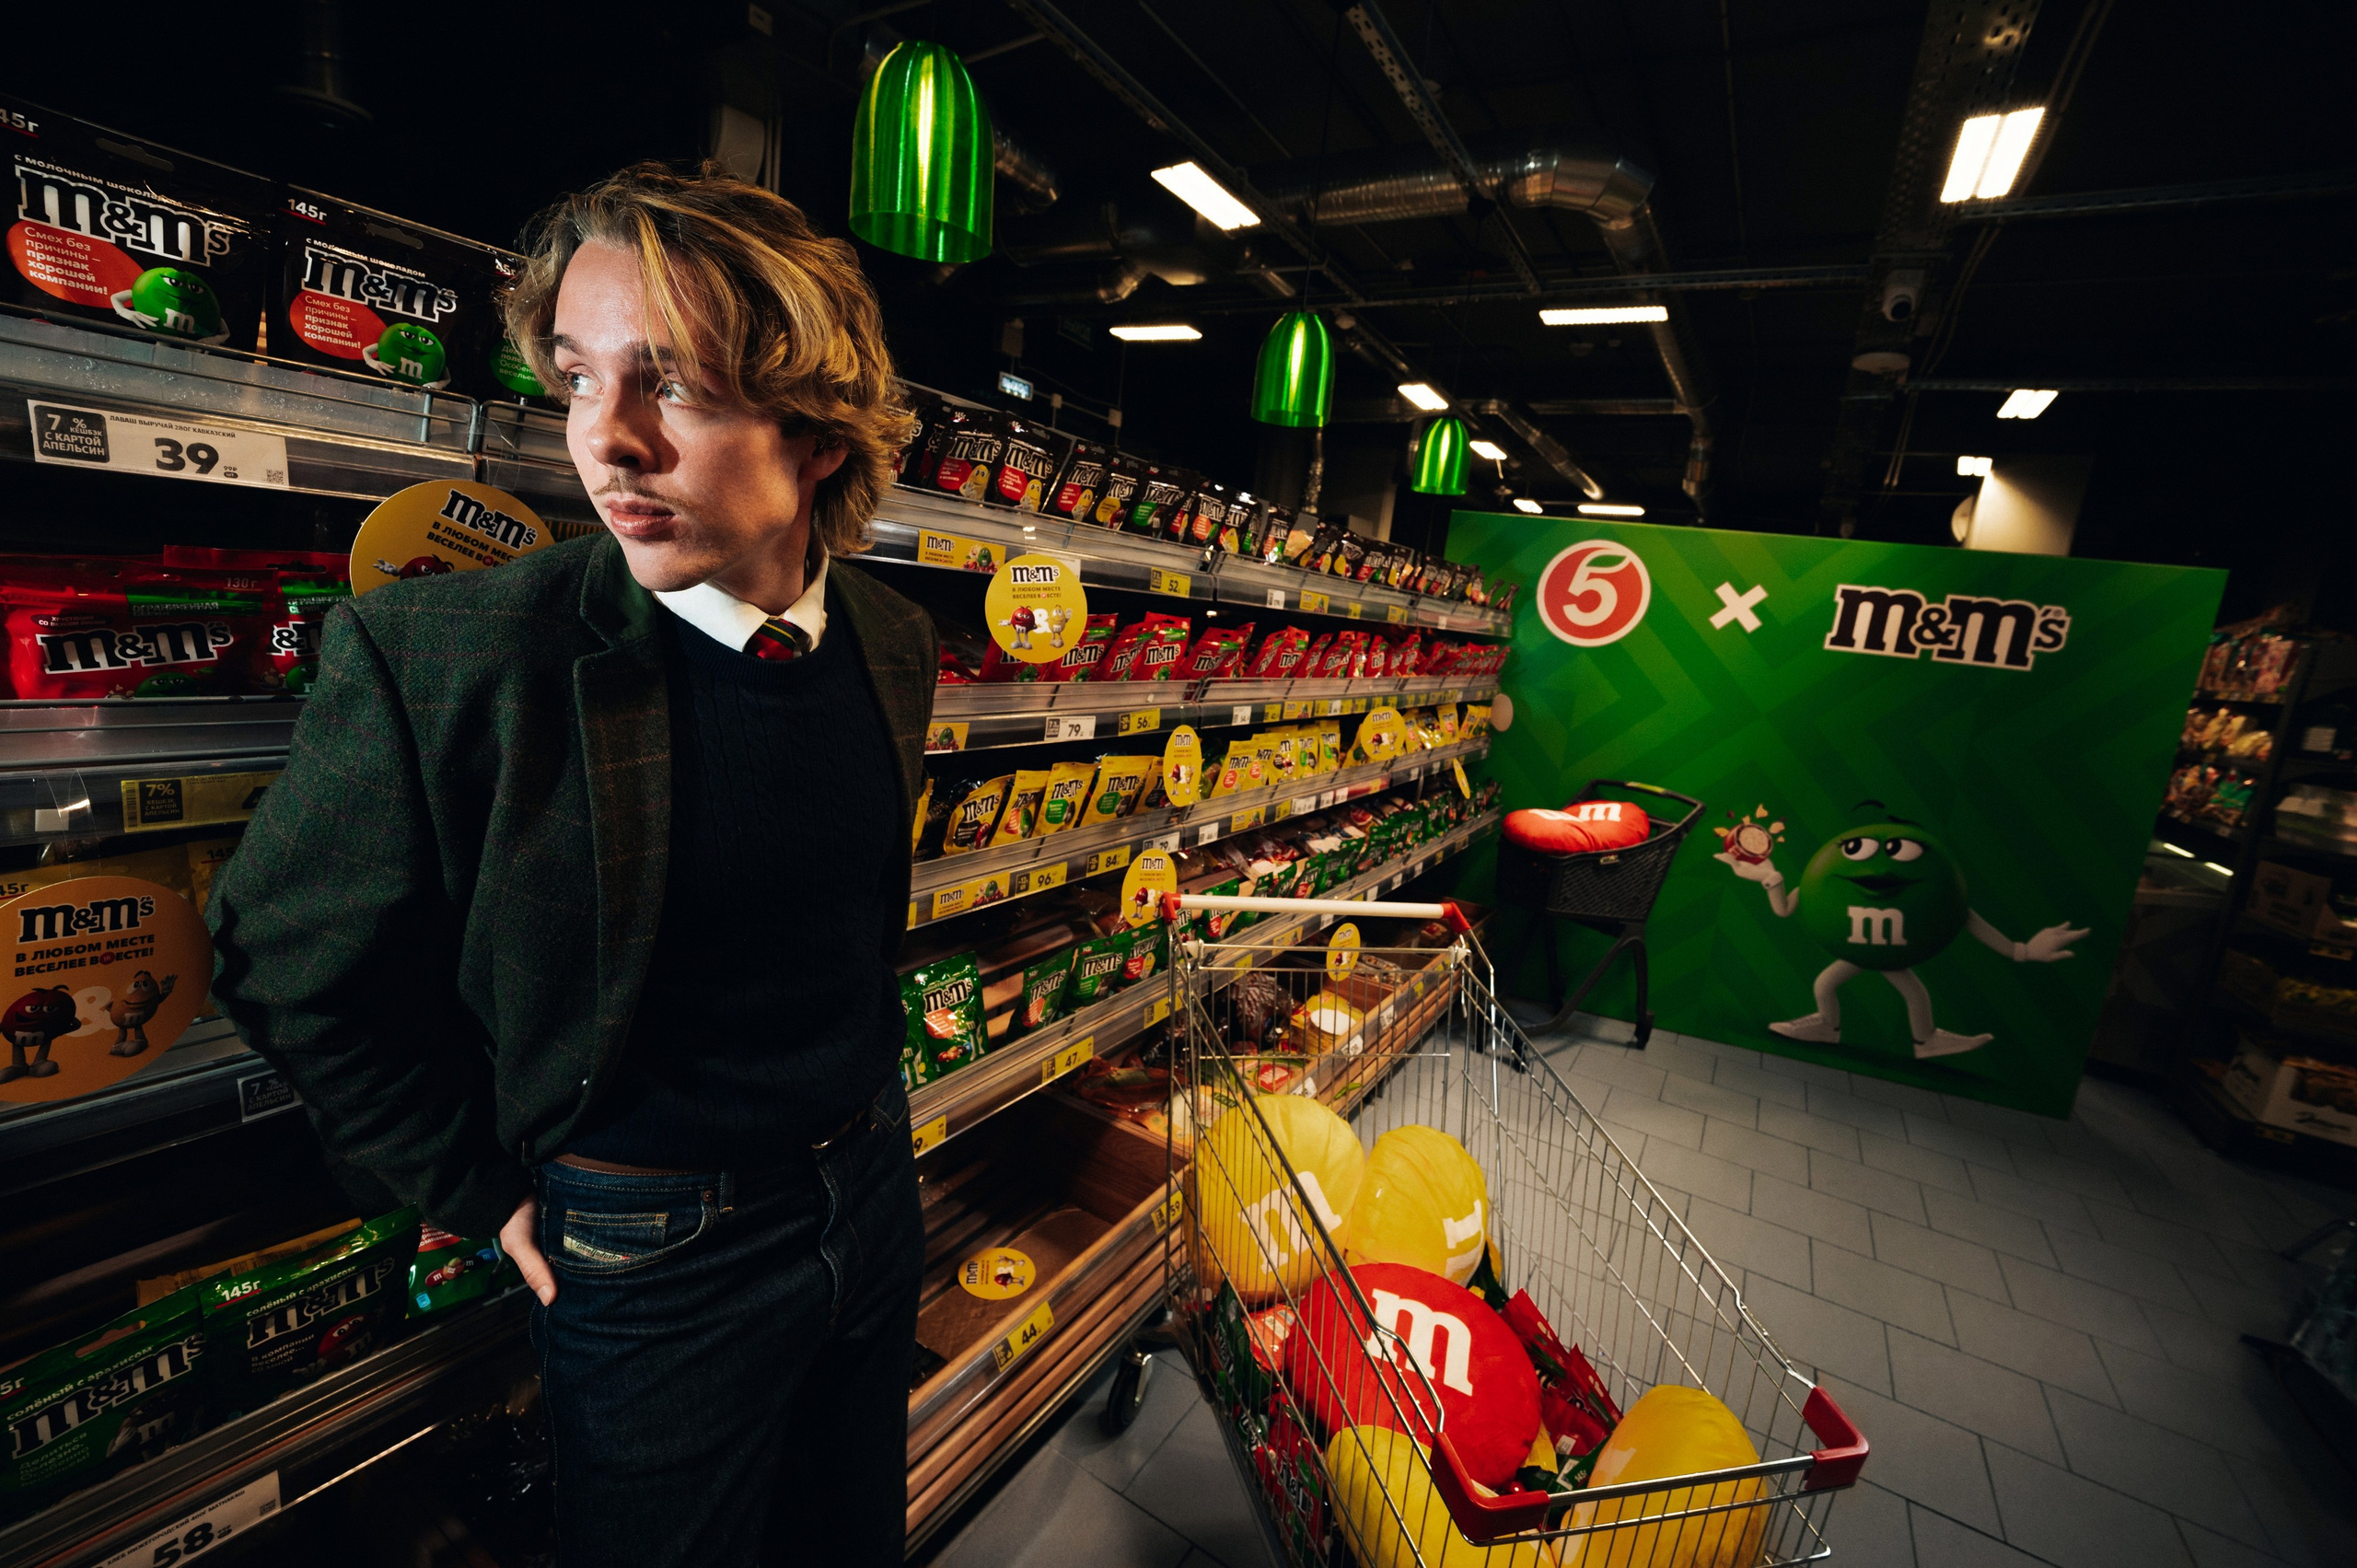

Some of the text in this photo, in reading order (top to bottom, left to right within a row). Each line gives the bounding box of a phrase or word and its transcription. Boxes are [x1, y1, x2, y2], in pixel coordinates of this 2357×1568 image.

[25, 156, 103, 185] молочным
[287, 198, 328, 221] 145г
[24, 226, 91, 252] Смех без
[26, 238, 88, 261] причины
[27, 250, 89, 272] признак
[28, 259, 96, 284] хорошей
[369, 256, 426, 278] шоколадом
[29, 269, 108, 296] компании!
[305, 295, 351, 314] Смех без
[305, 305, 348, 322] причины
[163, 308, 195, 334] m
[304, 322, 354, 340] хорошей
[305, 314, 349, 331] признак
[304, 331, 361, 349] компании!
[400, 355, 424, 380] m
[46, 413, 61, 430] 7
[69, 426, 103, 437] КЕШБЭК
[110, 415, 137, 425] ЛАВАШ
[138, 419, 174, 431] ВЫРУЧАЙ
[192, 427, 236, 439] КАВКАЗСКИЙ
[42, 441, 105, 457] АПЕЛЬСИН
[45, 431, 101, 447] С КАРТОЙ
[154, 437, 219, 474] 39
[426, 531, 475, 558] ВЕСЕЛЕЕ
[432, 521, 517, 562] В ЛЮБОМ МЕС
[1168, 579, 1178, 592] 52
[1068, 725, 1081, 737] 79
[1137, 716, 1147, 728] 56
[145, 783, 175, 797] 7%
[1578, 803, 1621, 822] m
[207, 847, 235, 859] 145
[1106, 854, 1117, 867] 84
[1038, 874, 1051, 887] 96
[1846, 904, 1908, 947] m
[16, 935, 156, 963] В ЛЮБОМ МЕСТЕ
[14, 959, 87, 977] ВЕСЕЛЕЕ
[1065, 1051, 1078, 1067] 47
[256, 1087, 289, 1101] КАРТОЙ
[221, 1281, 261, 1301] 145г
[246, 1292, 297, 1318] солёный
[307, 1265, 357, 1293] арахисом
[1021, 1323, 1038, 1344] 44
[1363, 1287, 1474, 1398] m
[261, 1333, 315, 1361] компании
[266, 1356, 293, 1371] мной
[6, 1382, 75, 1421] солёный
[87, 1345, 154, 1383] арахисом
[18, 1432, 88, 1470] Делиться
[107, 1553, 126, 1565] ХЛЕБ
[127, 1517, 190, 1555] НИЖЕГОРОДСКИЙ
[208, 1490, 245, 1512] МАТНАКАШ
[153, 1522, 215, 1568] 58
